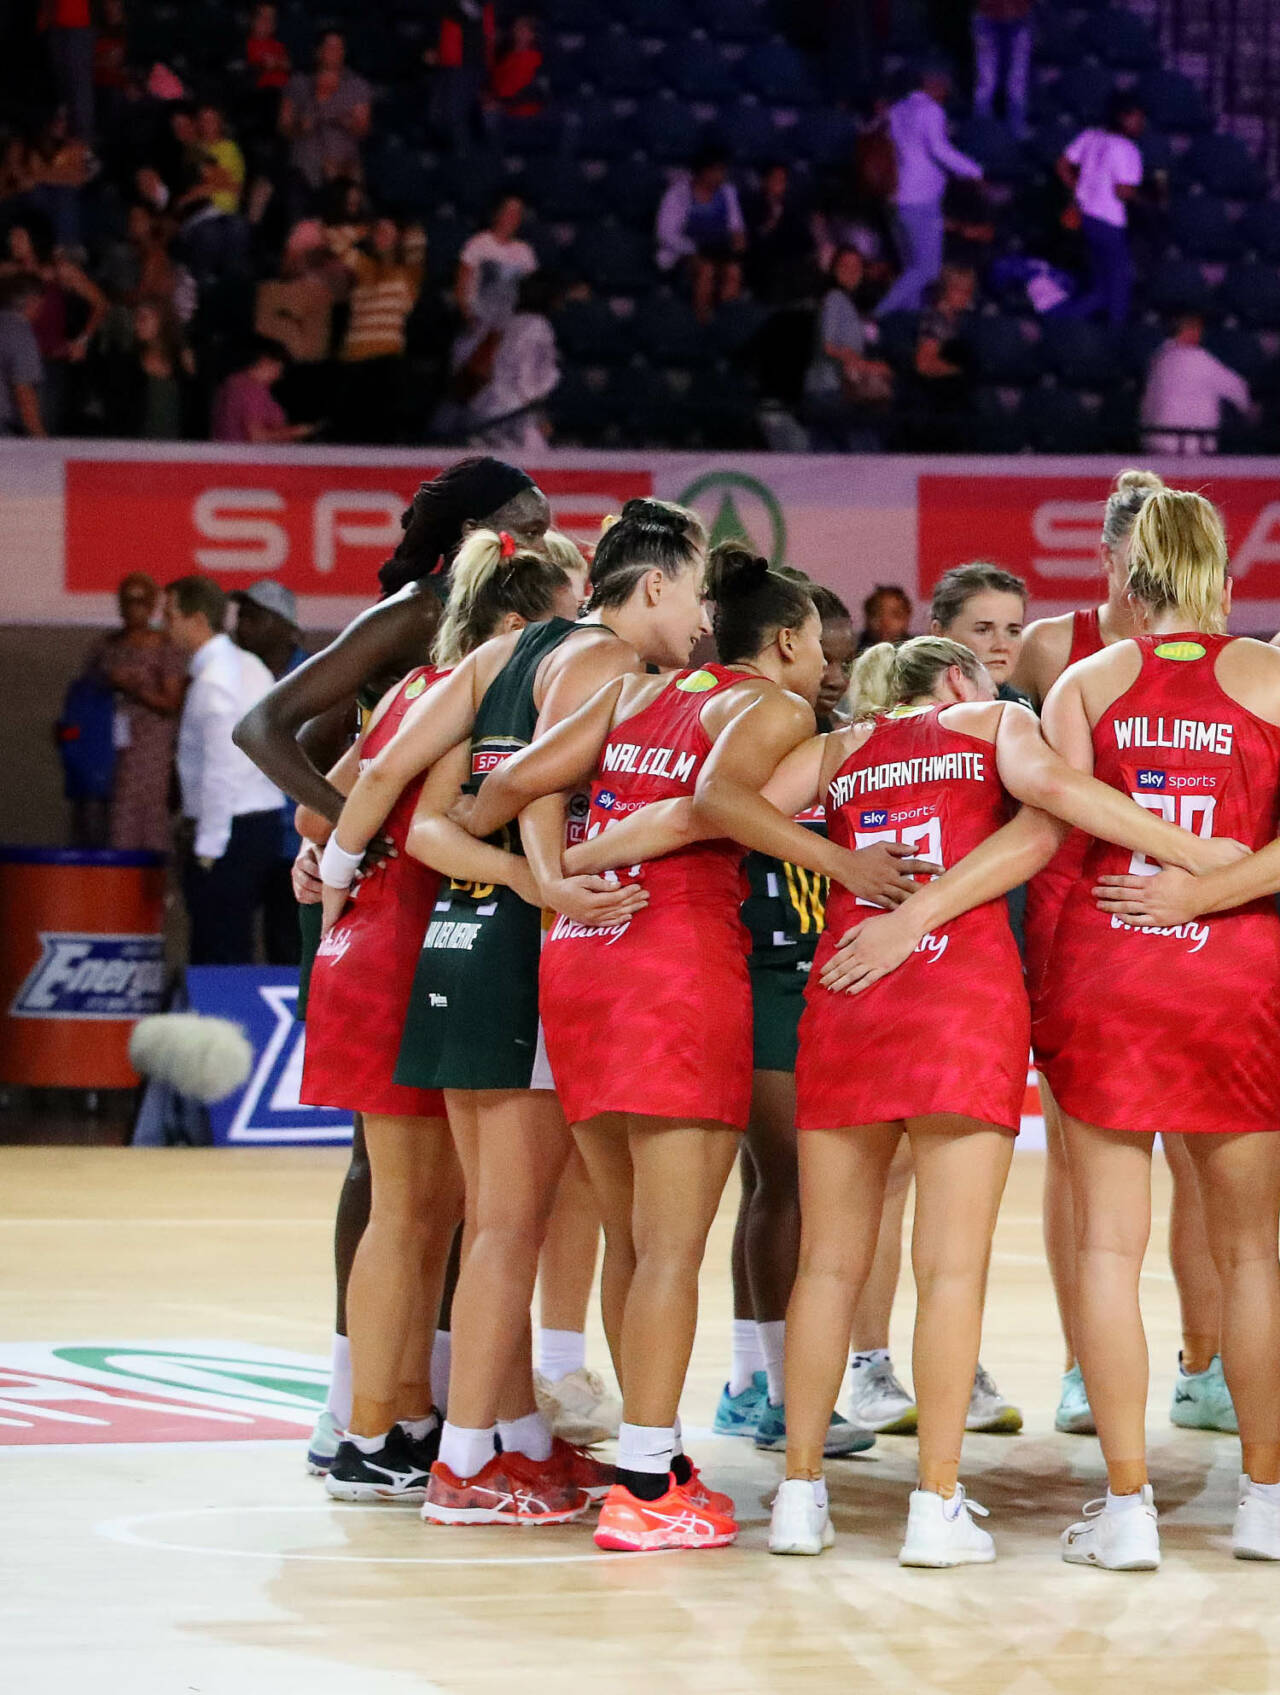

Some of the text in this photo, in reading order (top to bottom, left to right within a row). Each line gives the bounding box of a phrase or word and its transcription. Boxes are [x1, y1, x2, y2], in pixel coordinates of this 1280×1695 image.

[1113, 716, 1234, 755] WILLIAMS
[602, 743, 697, 783] MALCOLM
[1140, 770, 1217, 789] sky sports
[598, 792, 617, 809] sky
[863, 803, 937, 826] sky sports
